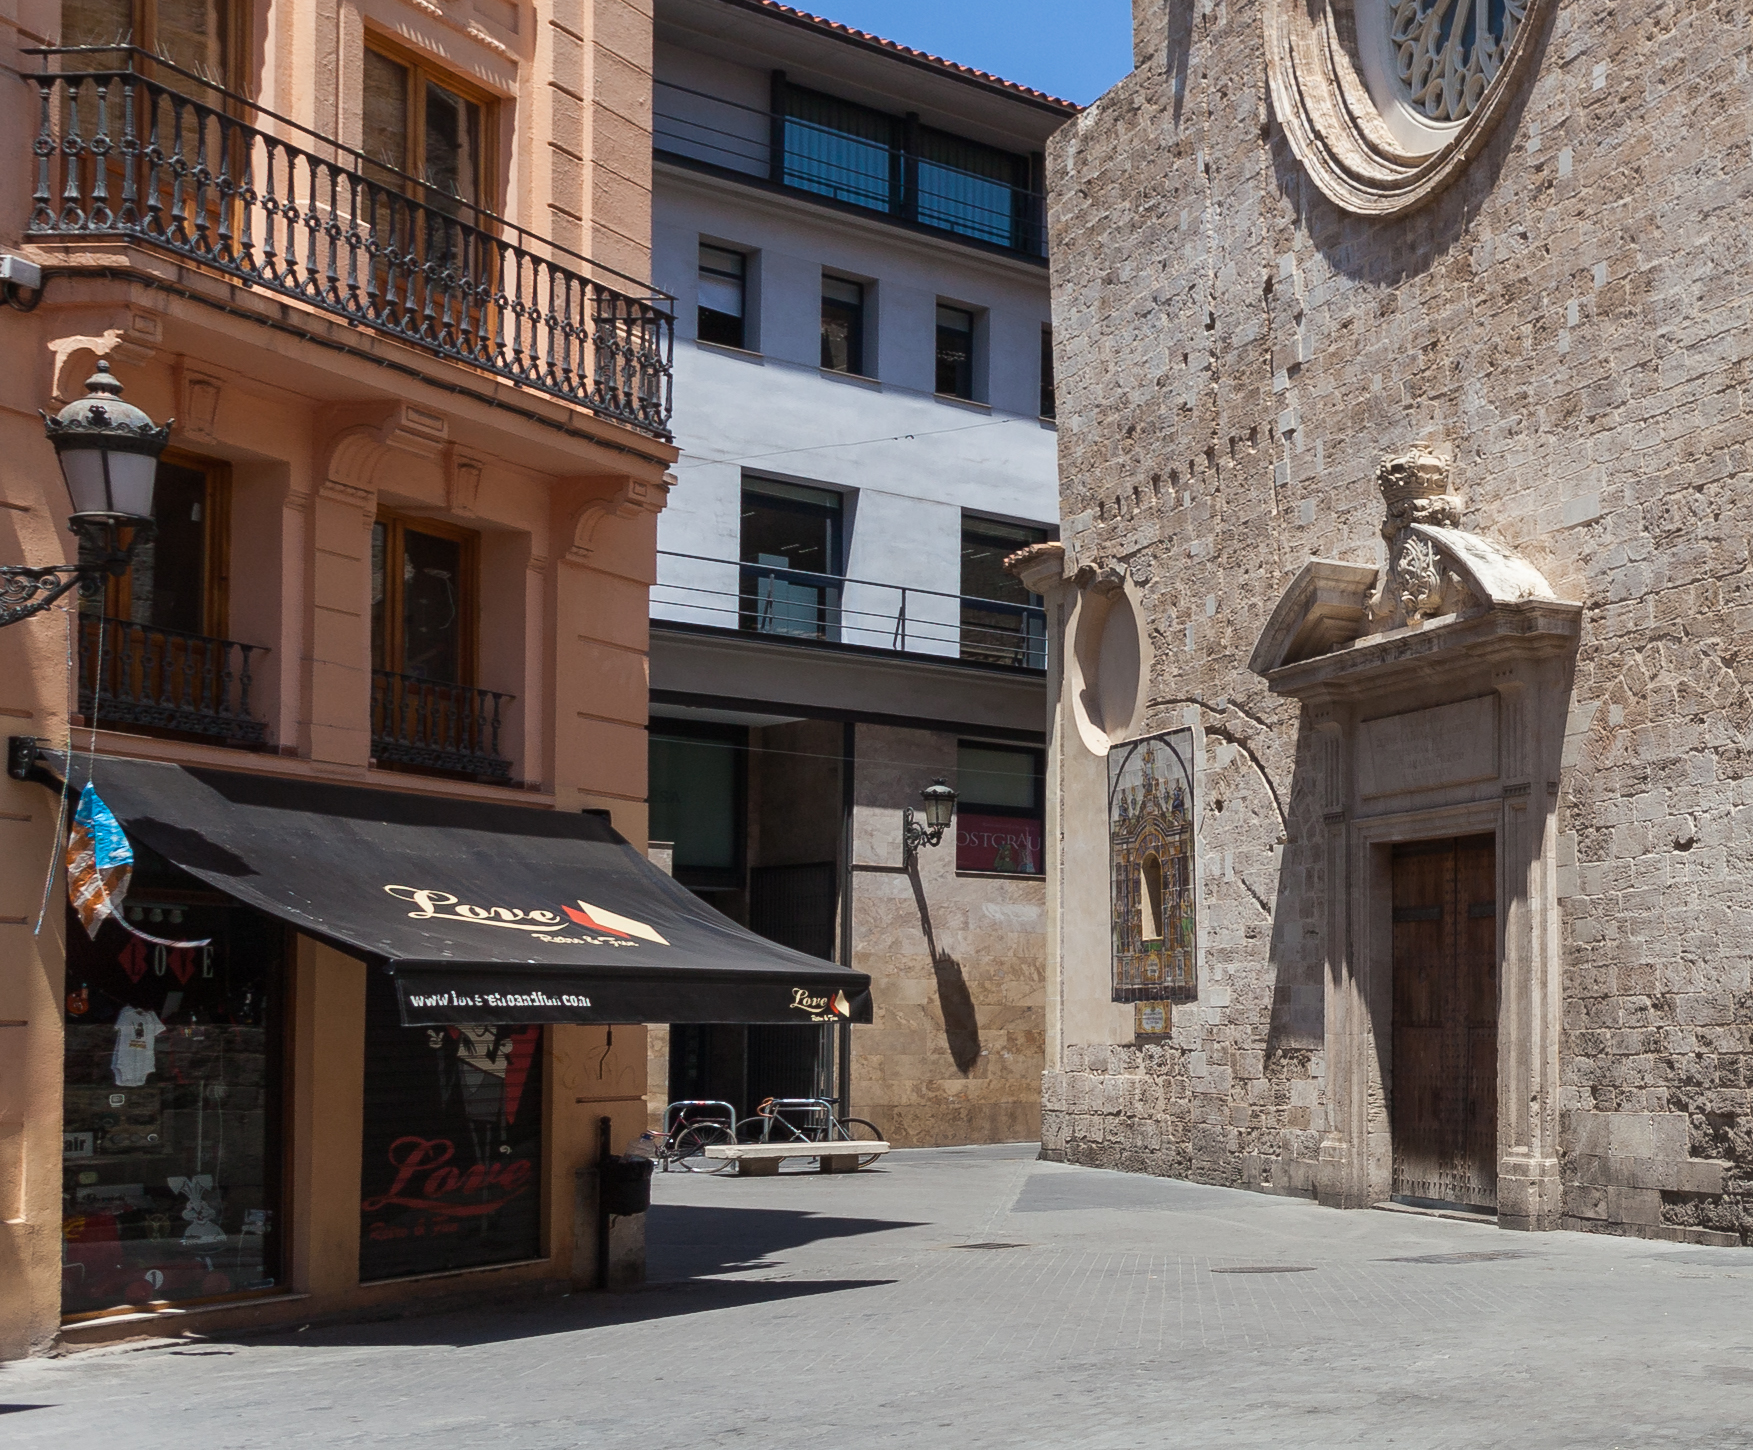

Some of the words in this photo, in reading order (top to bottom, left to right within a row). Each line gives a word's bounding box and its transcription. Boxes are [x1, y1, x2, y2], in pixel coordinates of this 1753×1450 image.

[383, 884, 569, 932] Love
[790, 988, 828, 1013] Love
[361, 1136, 531, 1217] Love
